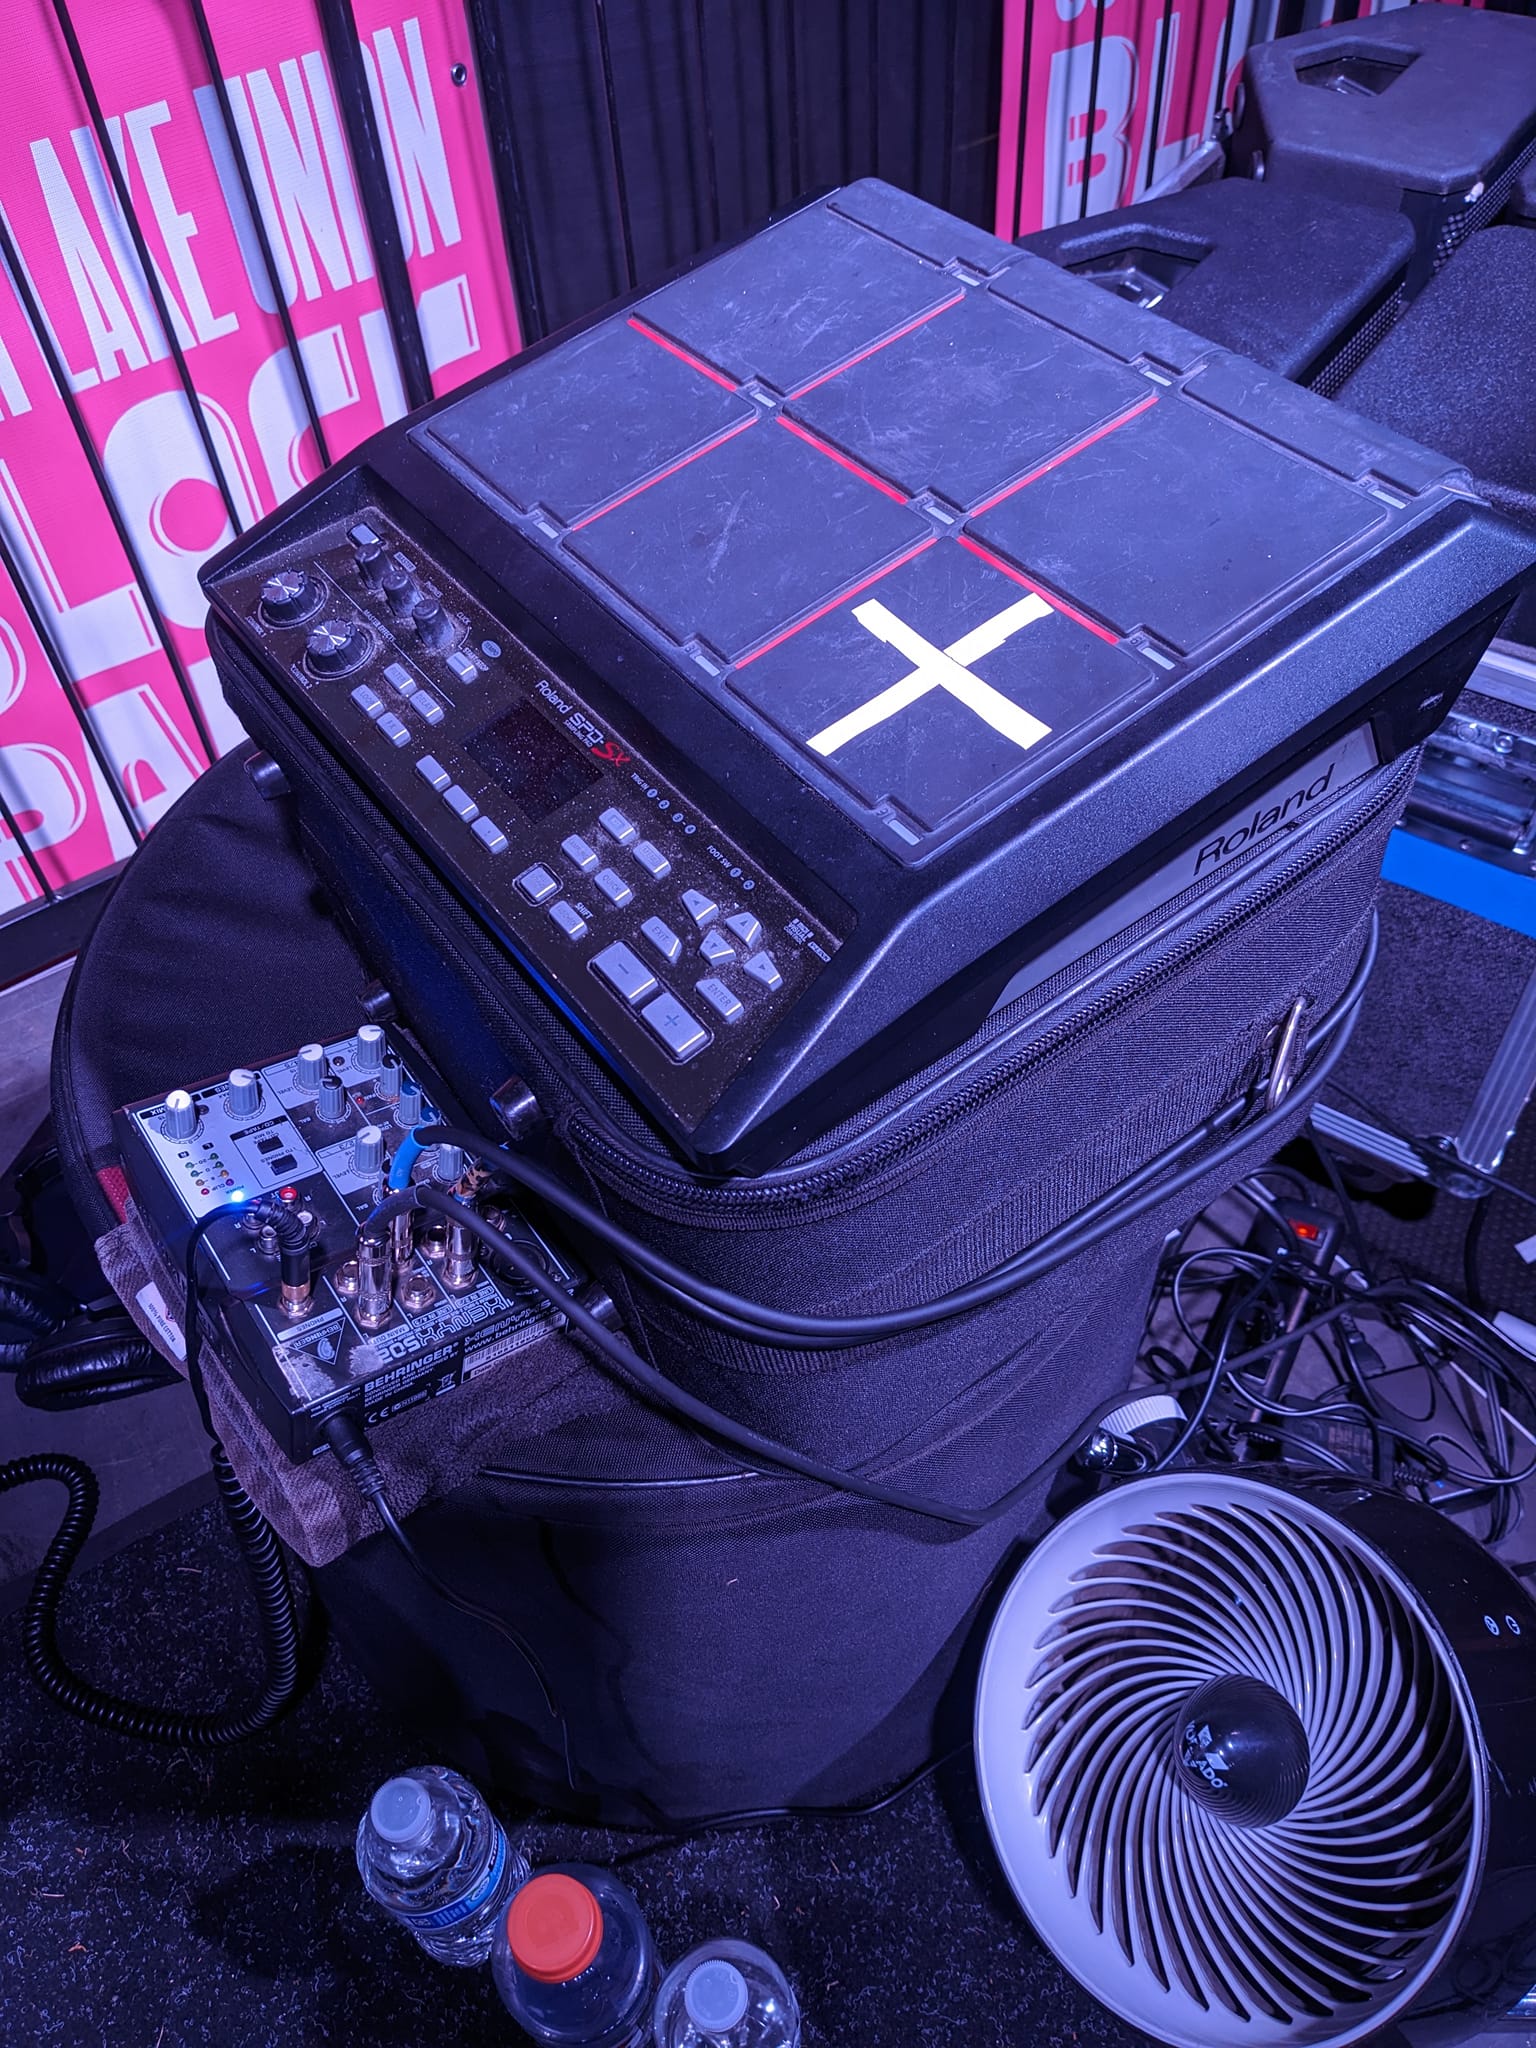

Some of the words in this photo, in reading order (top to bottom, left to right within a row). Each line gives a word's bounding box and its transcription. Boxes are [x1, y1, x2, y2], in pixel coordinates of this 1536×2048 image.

[0, 100, 239, 400] LAKE
[456, 610, 471, 626] CLICK
[535, 680, 572, 715] Roland
[563, 719, 585, 740] SAMPLING
[1192, 762, 1337, 877] Roland
[706, 844, 723, 861] FOOT
[719, 856, 732, 869] SW
[601, 873, 621, 893] QUICK
[576, 902, 593, 920] SHIFT
[650, 924, 669, 943] EXIT
[707, 982, 731, 1007] ENTER
[162, 1325, 177, 1343] COTTON
[295, 1315, 325, 1332] PHONES
[386, 1326, 405, 1337] MAIN
[293, 1322, 339, 1347] BEHRINGER
[363, 1377, 401, 1397] CONCEIVED
[414, 1355, 449, 1374] DESIGNED
[364, 1382, 402, 1402] BEHRINGER
[401, 1367, 433, 1385] GERMANY
[363, 1395, 384, 1407] MADE
